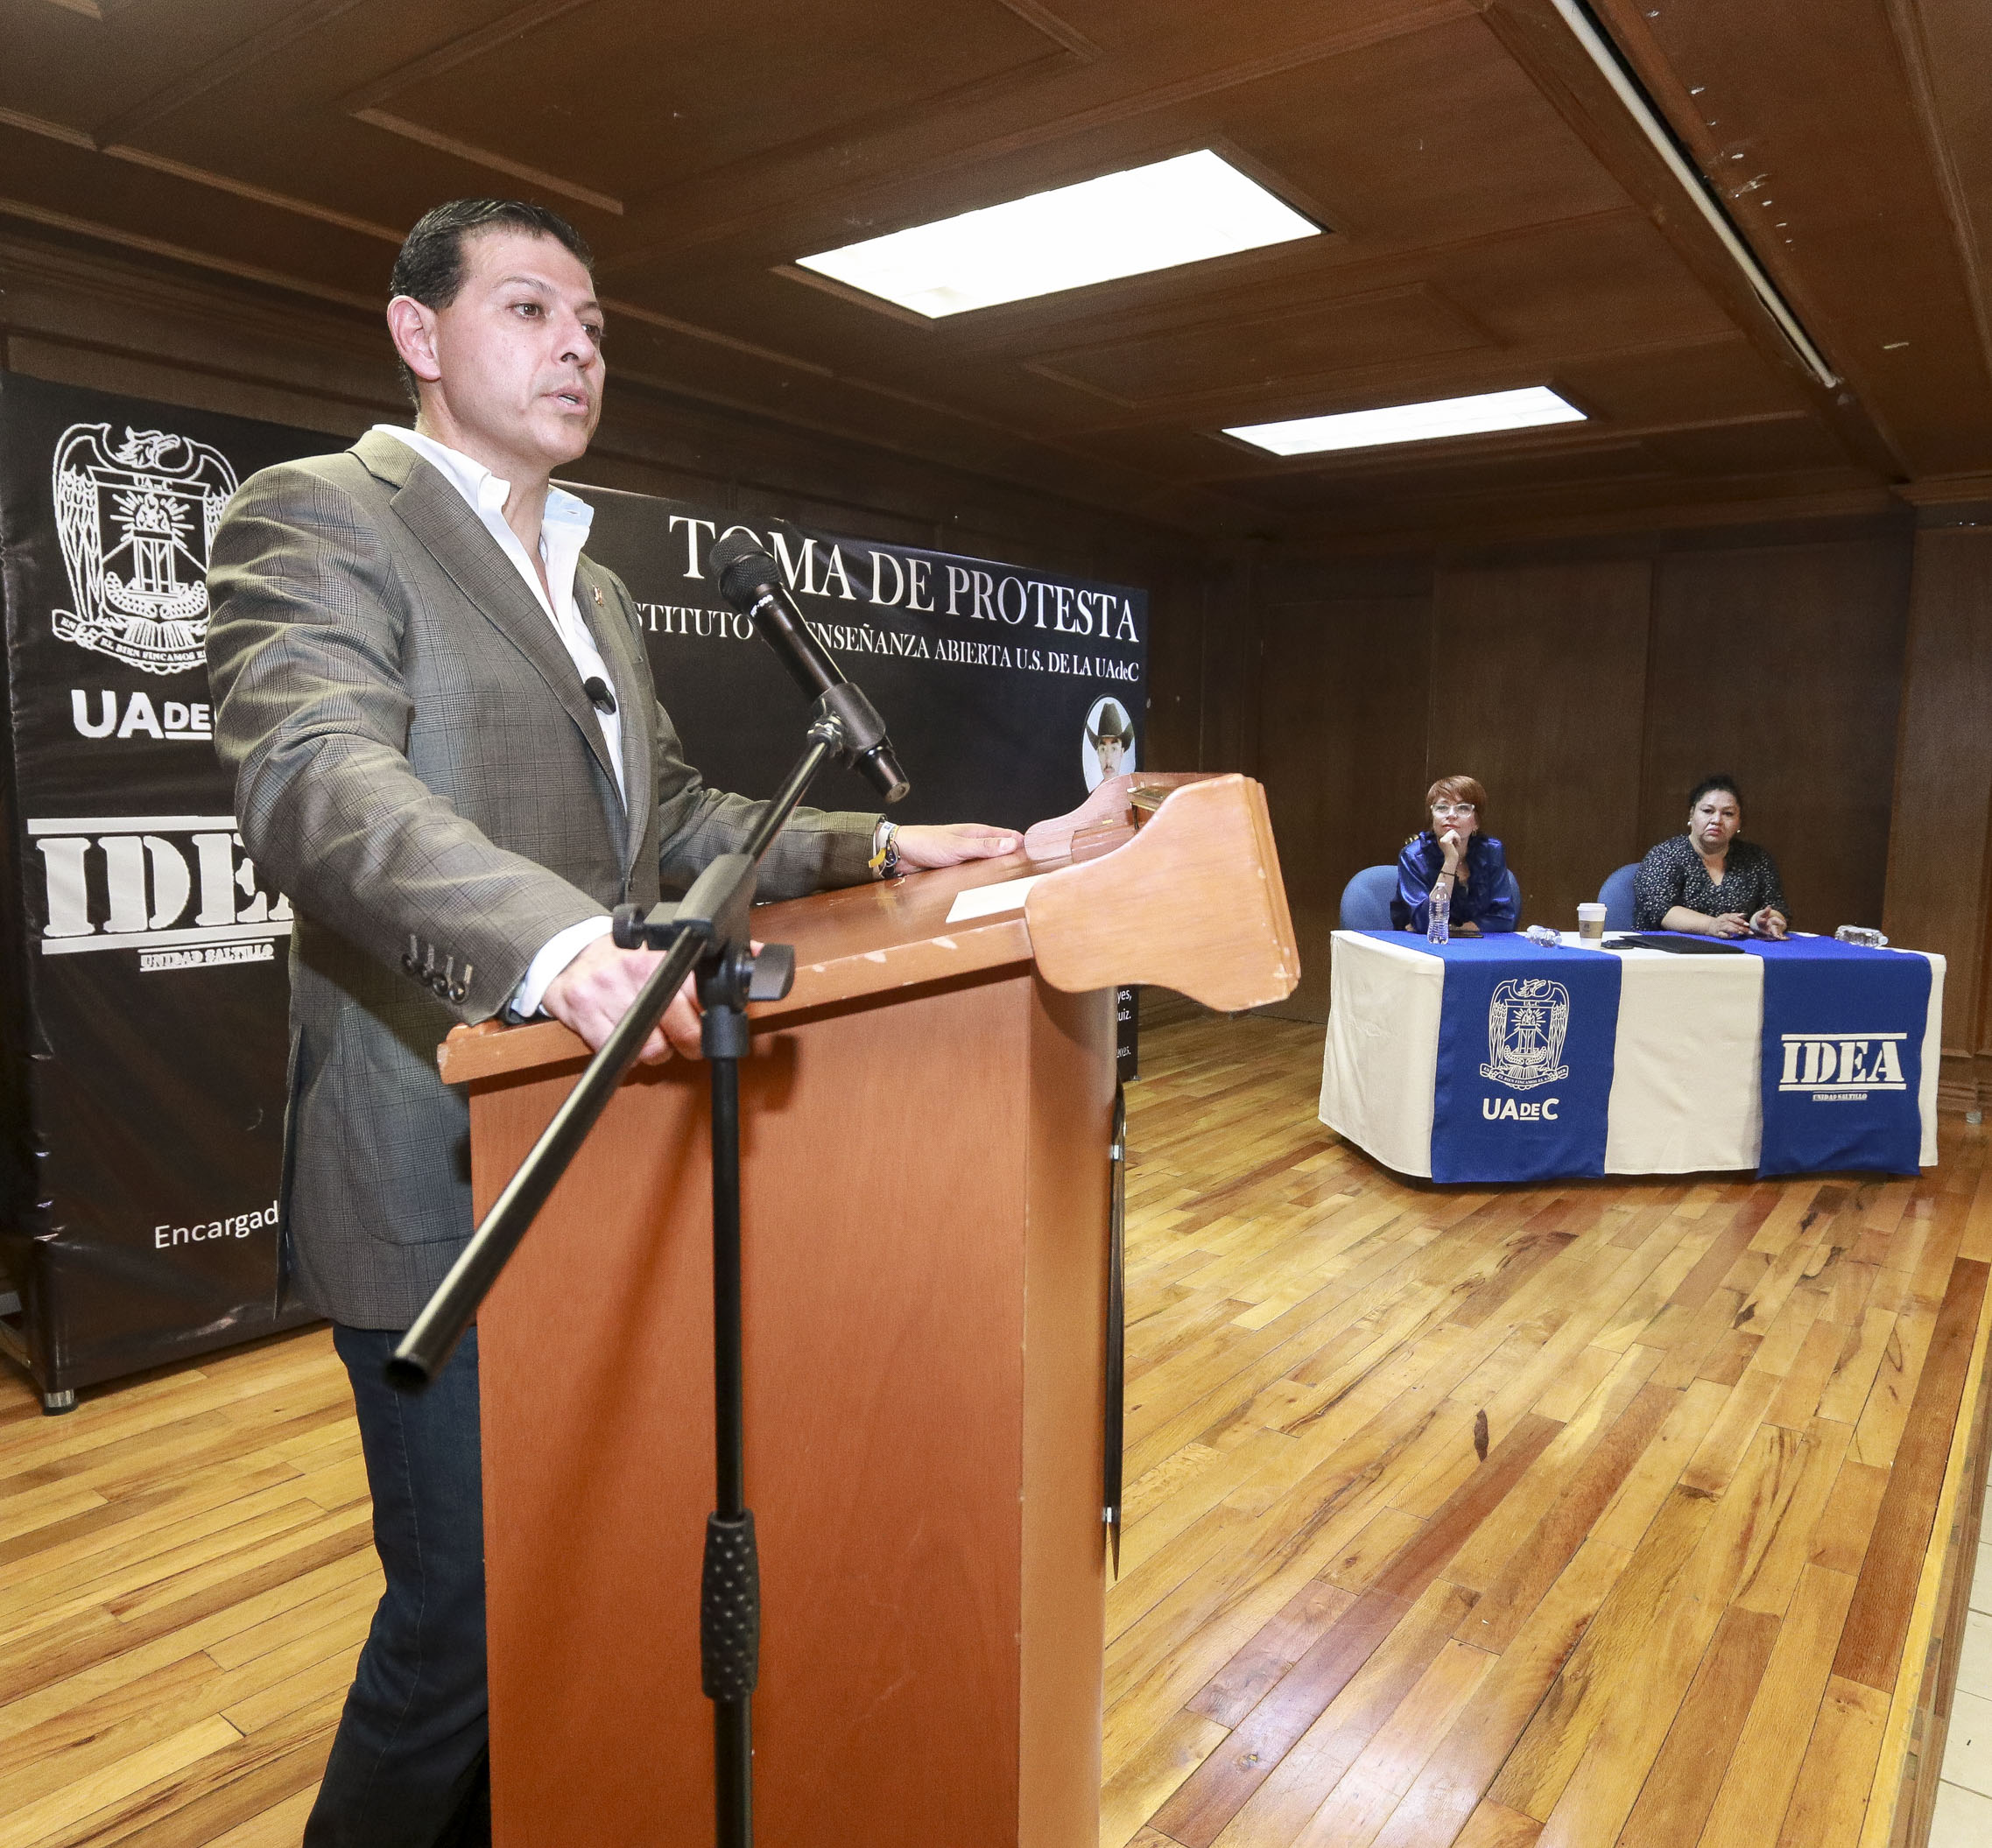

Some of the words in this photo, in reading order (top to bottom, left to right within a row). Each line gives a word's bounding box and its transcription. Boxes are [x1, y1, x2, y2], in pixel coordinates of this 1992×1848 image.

[669, 515, 856, 601] TMA
[869, 551, 934, 610] DE
[946, 565, 1139, 643] PROTESTA
[934, 638, 1012, 668] ABIERTA
[1016, 647, 1044, 671] U.S.
[1048, 651, 1070, 674] DE
[1073, 655, 1092, 677] LA
[1095, 657, 1139, 682] UAdeC
[71, 689, 217, 741] UADE
[36, 833, 294, 938] IDE
[140, 950, 204, 968] UNIDAD
[205, 944, 274, 964] SALTILLO
[1779, 1041, 1905, 1084] IDEA
